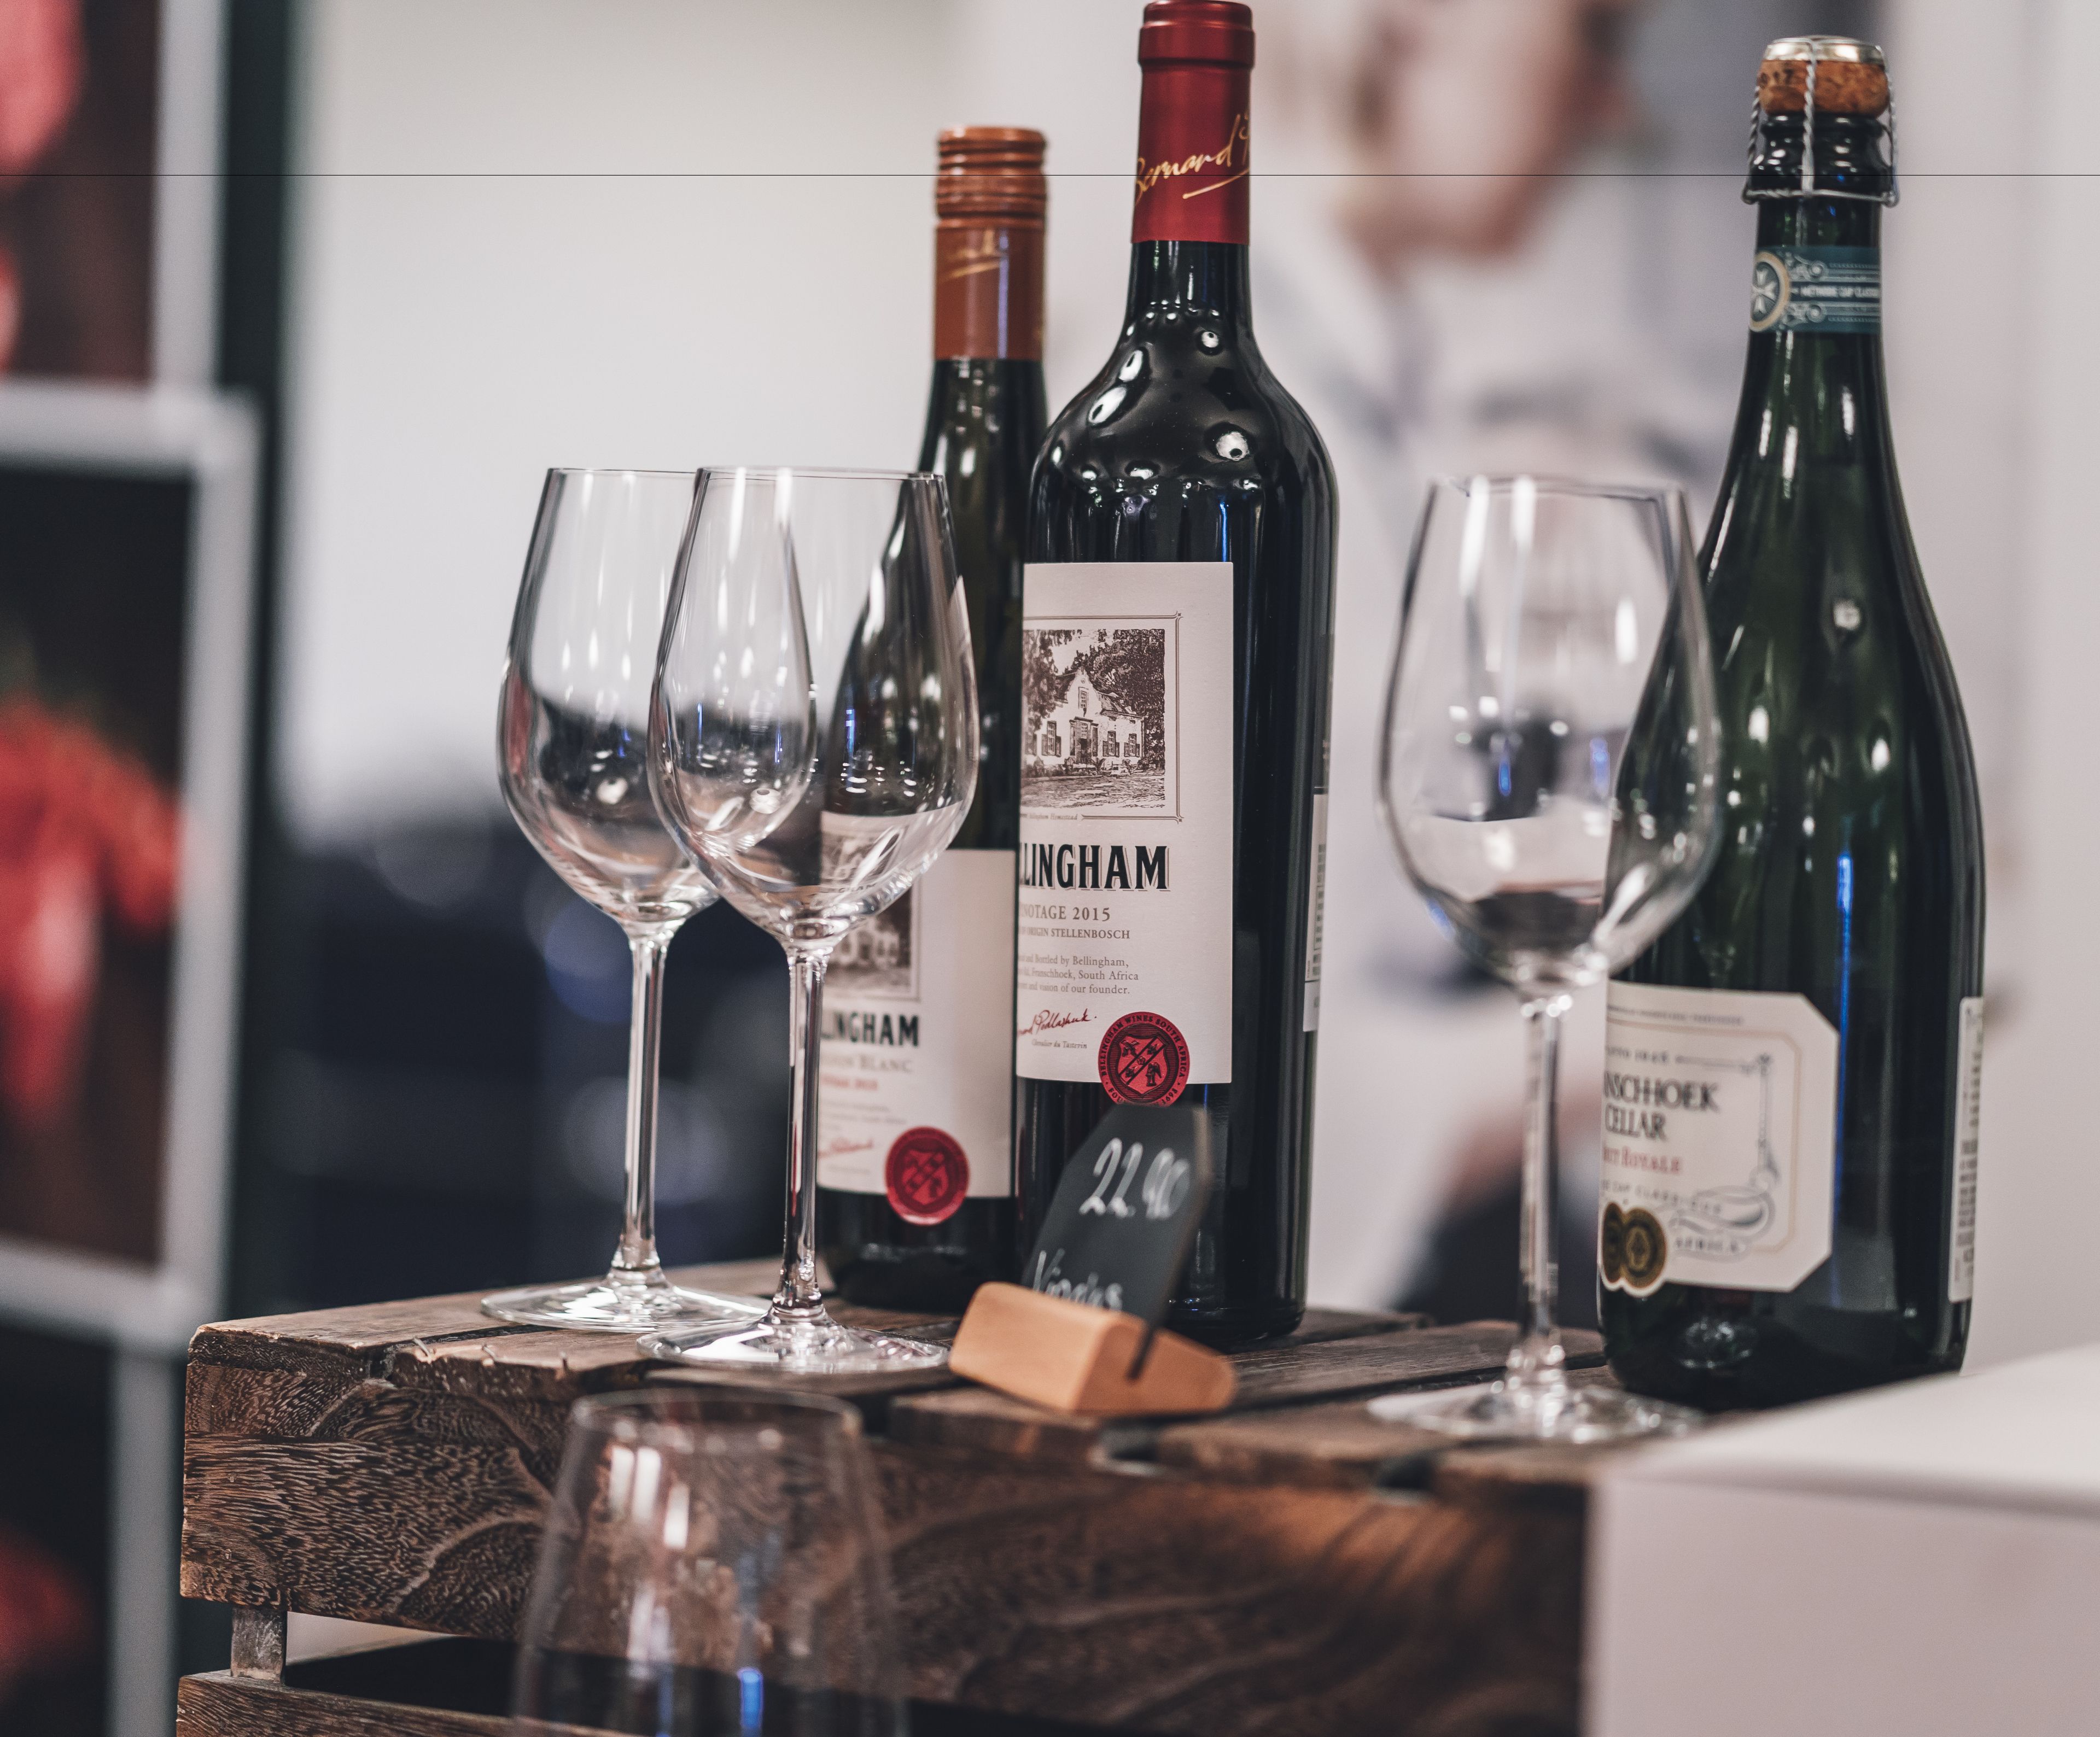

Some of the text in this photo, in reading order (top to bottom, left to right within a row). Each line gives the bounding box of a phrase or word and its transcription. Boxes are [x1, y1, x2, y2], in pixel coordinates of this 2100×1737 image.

[1019, 843, 1171, 891] LINGHAM
[1072, 907, 1110, 921] 2015
[1051, 928, 1130, 939] STELLENBOSCH
[1035, 954, 1058, 964] Bottled
[1060, 955, 1070, 967] by
[1072, 956, 1129, 968] Bellingham,
[1078, 970, 1105, 980] South
[1109, 971, 1139, 980] Africa
[1060, 983, 1070, 992] of
[1089, 984, 1130, 994] founder.
[1099, 1015, 1187, 1078] BELLINGHAM WINES SOUTH AFRICA
[1605, 1103, 1668, 1142] CELLAR
